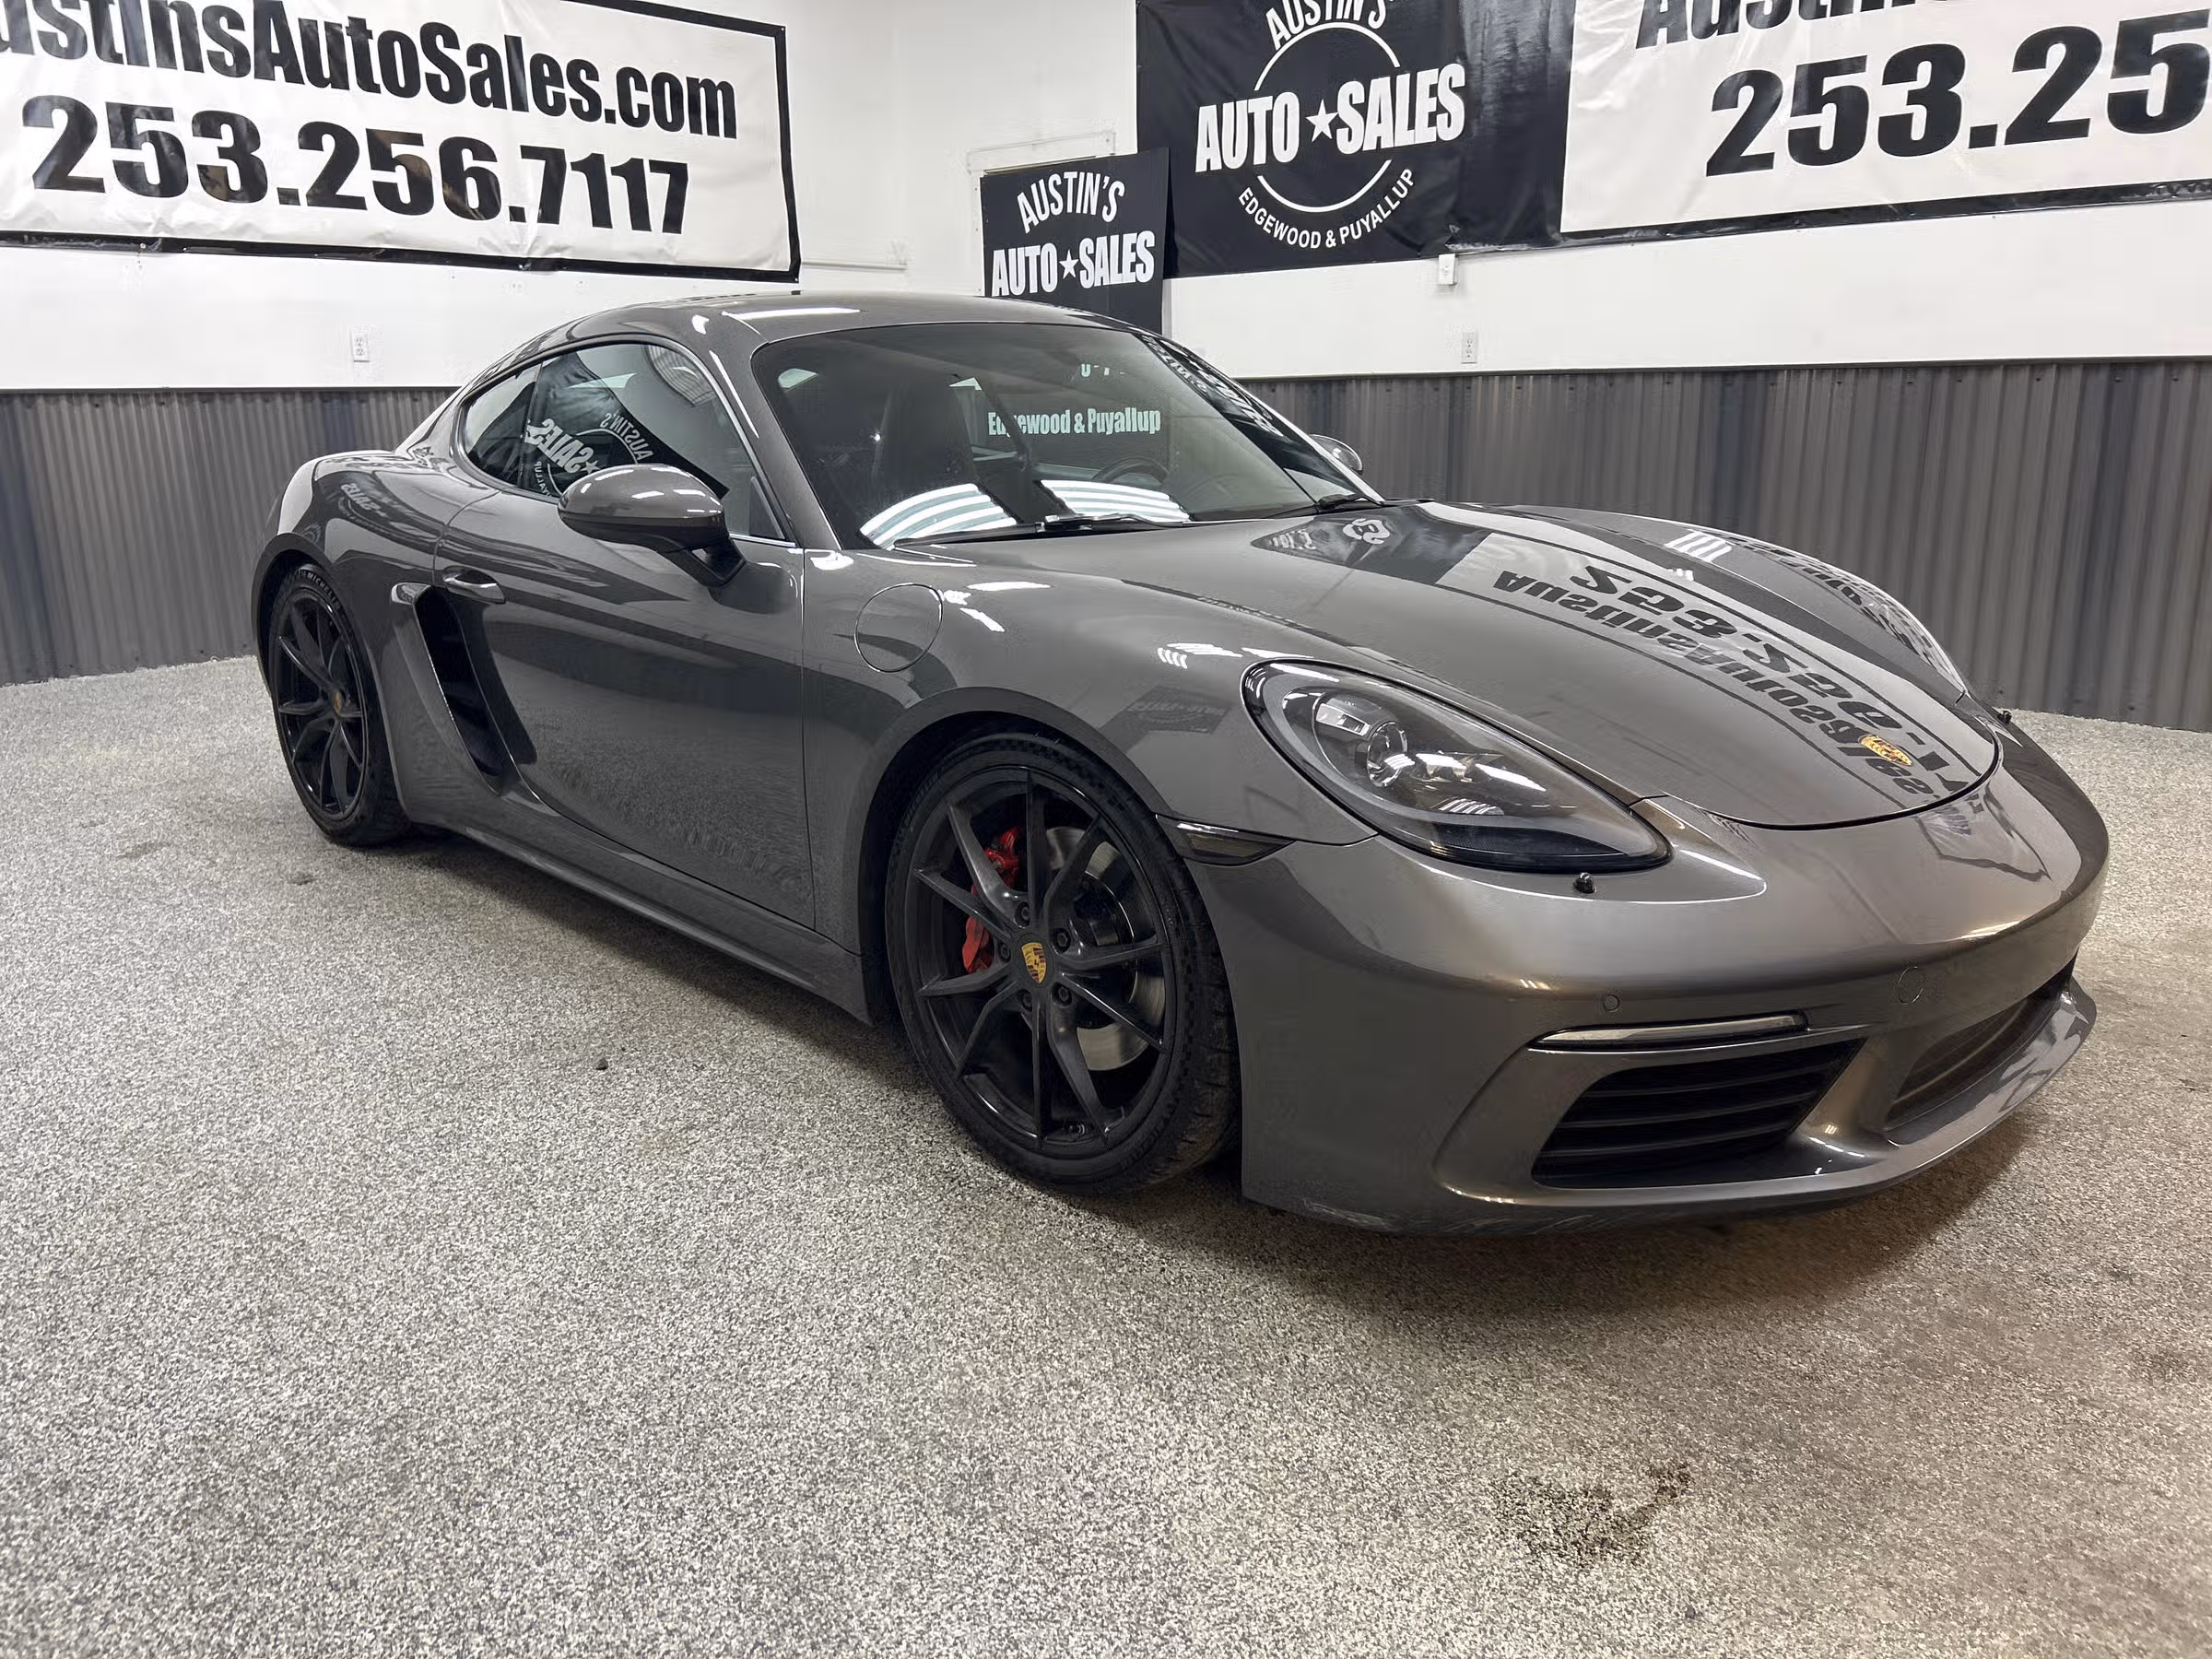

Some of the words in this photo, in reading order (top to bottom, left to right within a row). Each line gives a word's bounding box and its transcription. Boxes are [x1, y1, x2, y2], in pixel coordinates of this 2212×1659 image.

[1195, 91, 1300, 172] AUTO
[1336, 64, 1465, 155] SALES
[1706, 9, 2210, 177] 253.25
[22, 95, 689, 235] 253.256.7117
[1017, 171, 1125, 233] AUSTIN'S
[1239, 187, 1321, 249] EDGEWOOD
[1325, 229, 1336, 248] &
[1339, 169, 1415, 243] PUYALLUP
[991, 242, 1058, 297] AUTO
[1079, 230, 1155, 289] SALES
[988, 409, 1070, 438] Edewood
[1074, 412, 1085, 434] &
[1088, 406, 1161, 435] Puyallup
